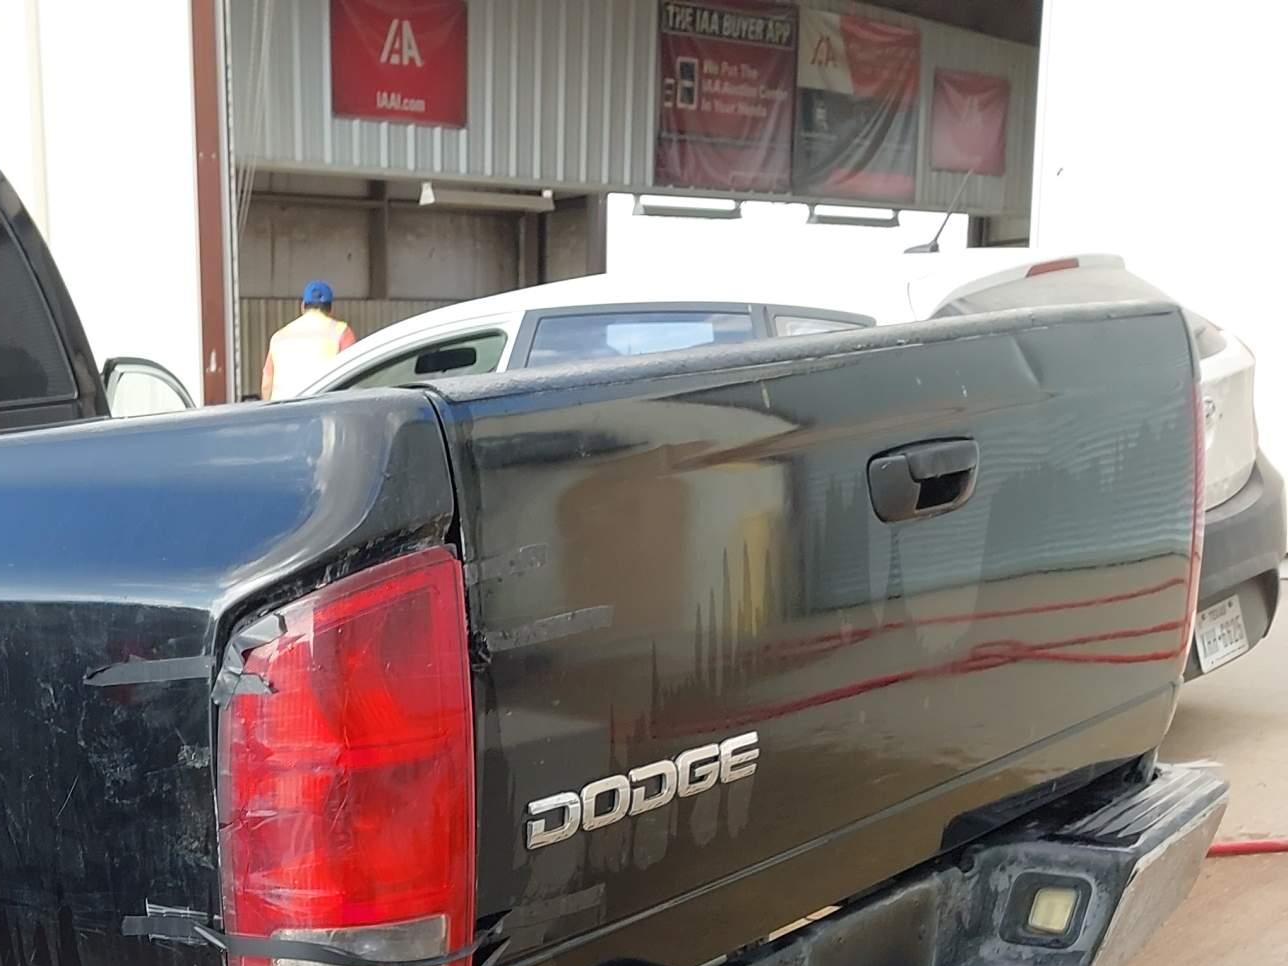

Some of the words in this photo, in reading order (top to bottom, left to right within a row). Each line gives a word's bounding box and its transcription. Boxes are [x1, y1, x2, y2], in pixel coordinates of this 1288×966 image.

[666, 5, 693, 32] THE
[695, 8, 720, 35] IAA
[722, 13, 764, 41] BUYER
[765, 19, 791, 45] APP
[376, 90, 426, 112] IAAI.com
[526, 731, 761, 850] DODGE
